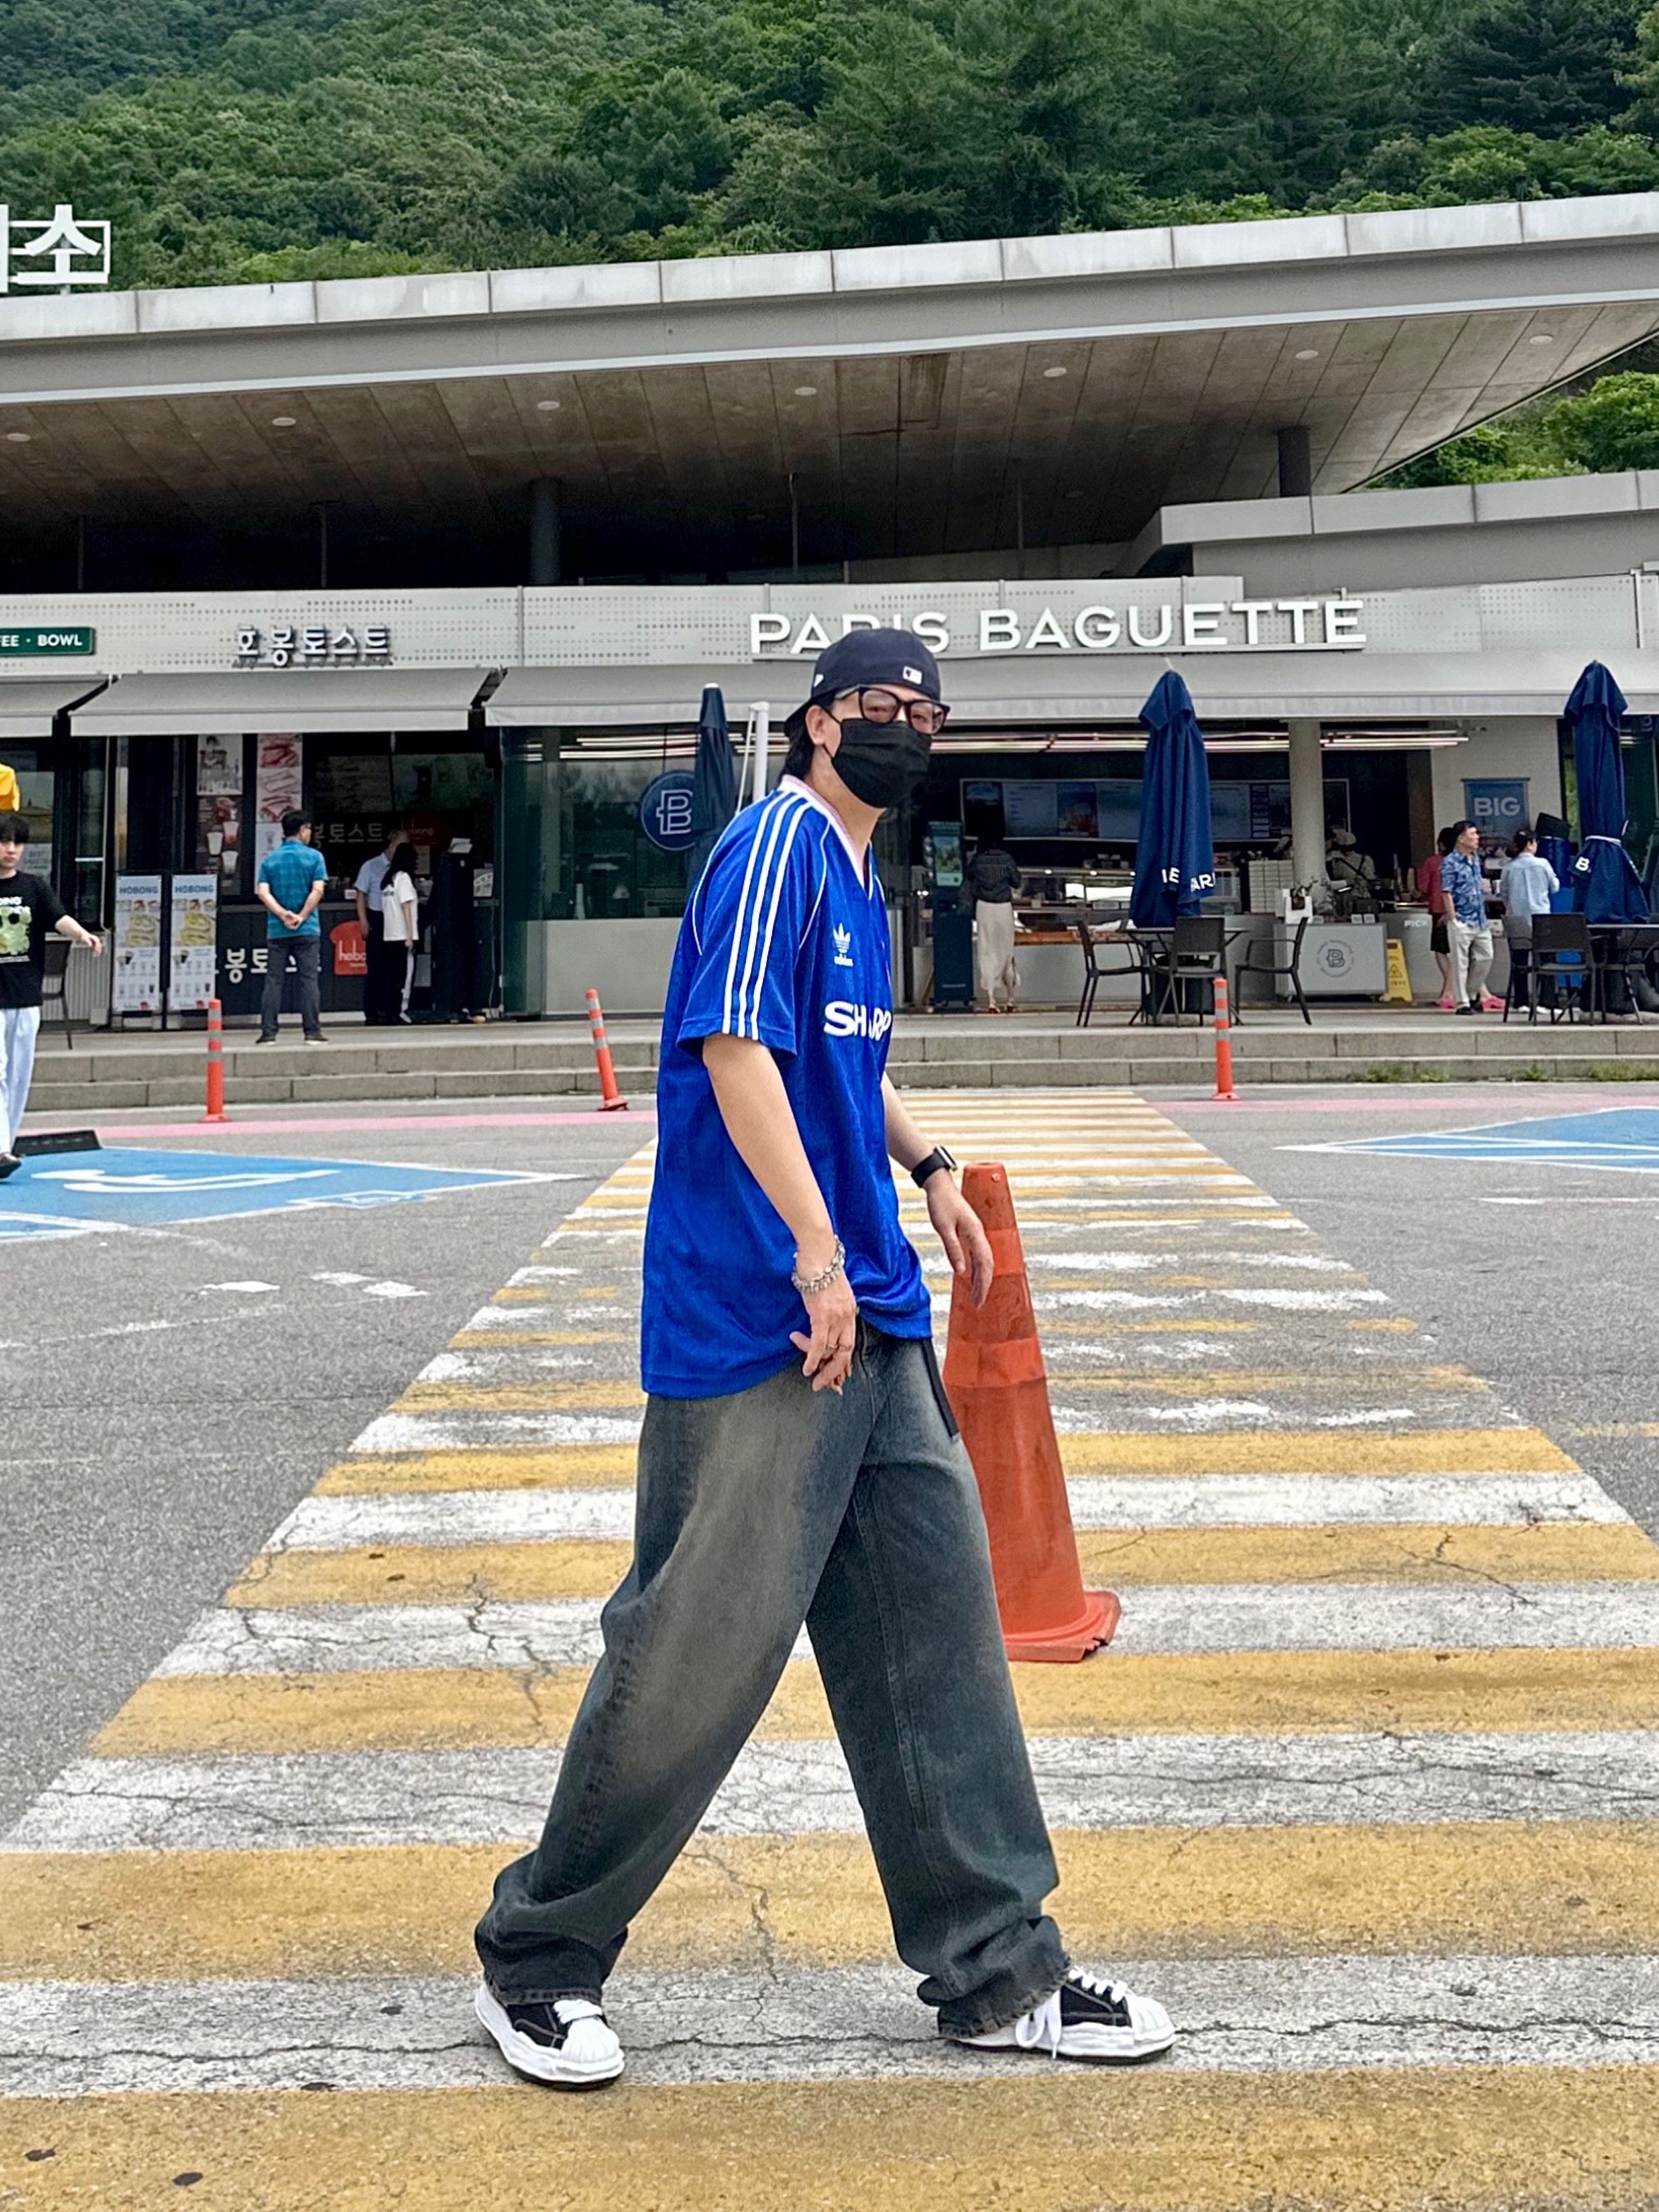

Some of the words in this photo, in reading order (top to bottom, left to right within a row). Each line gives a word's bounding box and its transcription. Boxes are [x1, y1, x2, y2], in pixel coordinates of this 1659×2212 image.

[0, 634, 20, 647] EE
[37, 633, 83, 647] BOWL
[980, 600, 1367, 650] BAGUETTE
[235, 625, 389, 667] 호봉토스트
[1474, 796, 1521, 817] BIG
